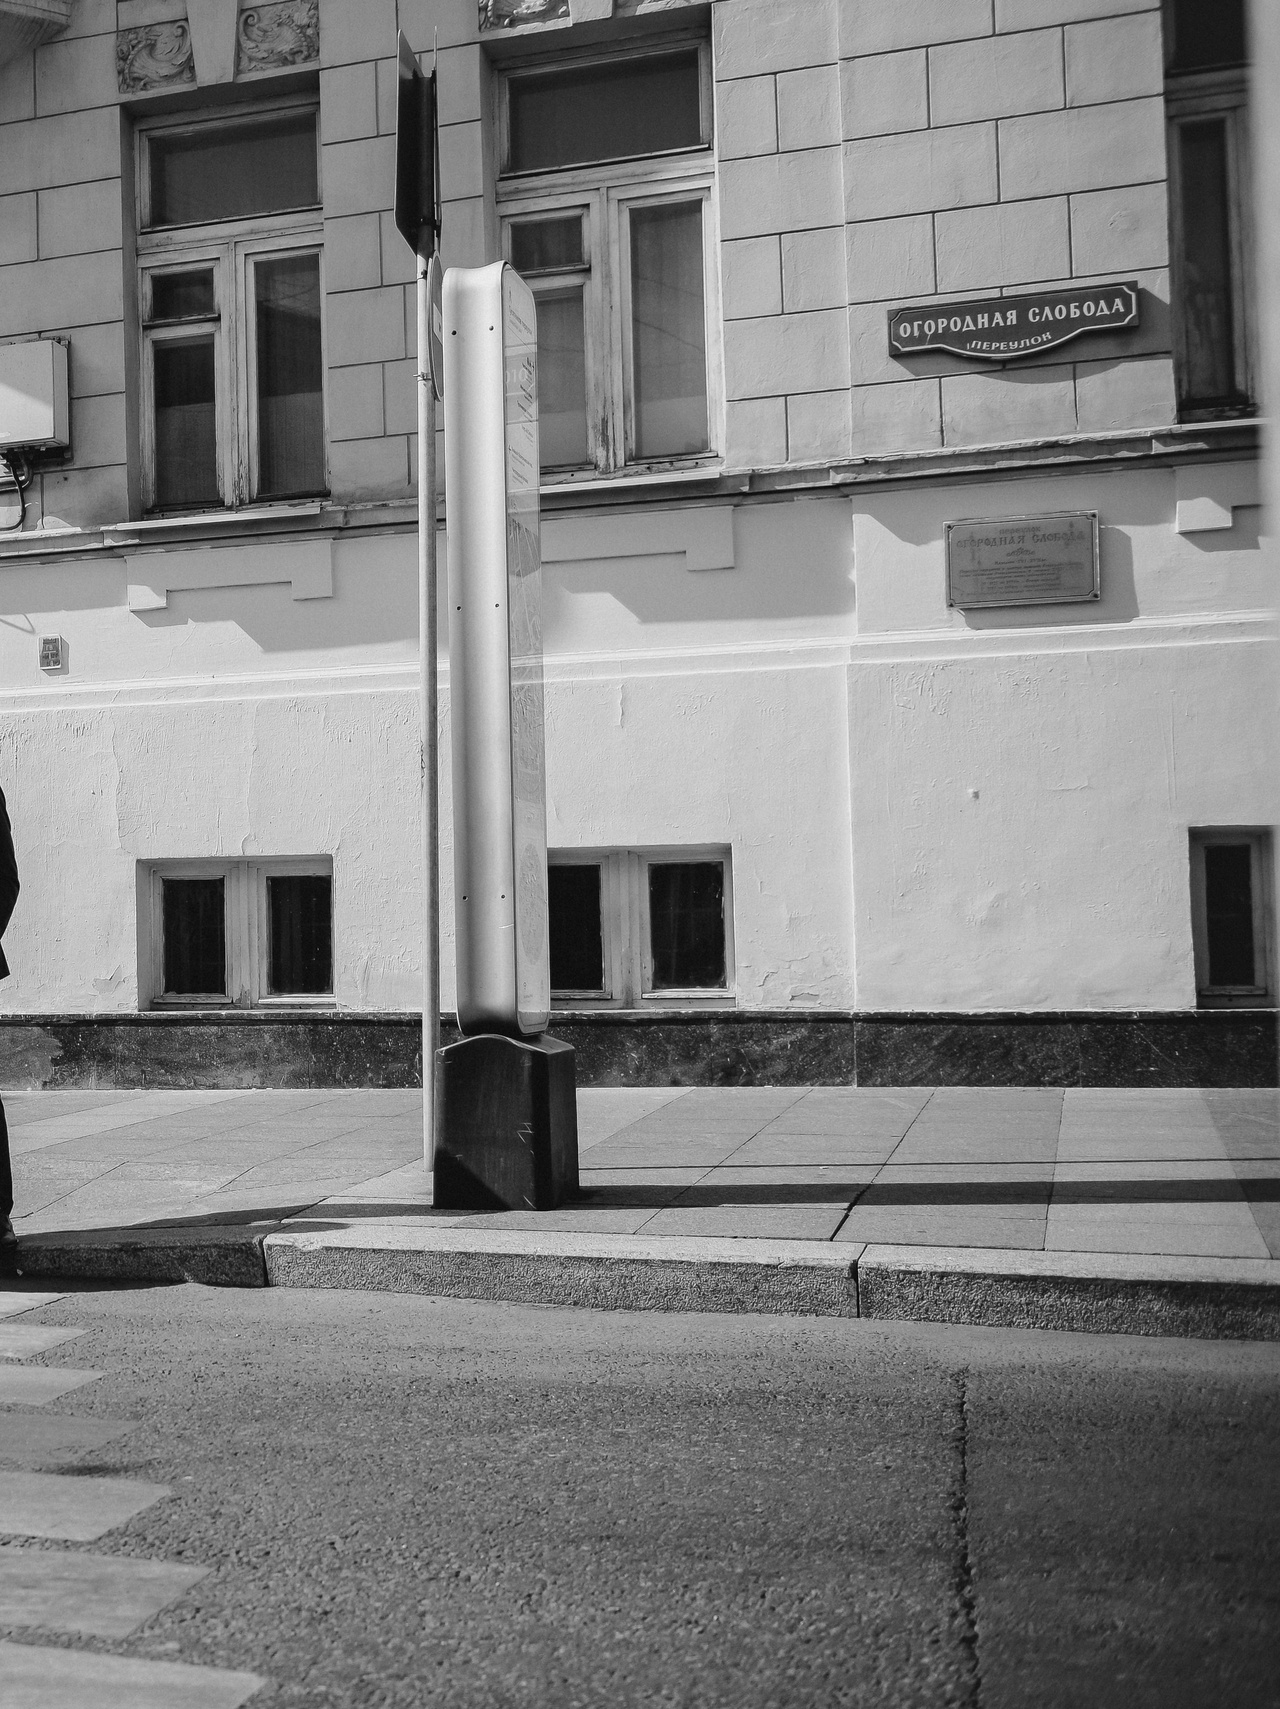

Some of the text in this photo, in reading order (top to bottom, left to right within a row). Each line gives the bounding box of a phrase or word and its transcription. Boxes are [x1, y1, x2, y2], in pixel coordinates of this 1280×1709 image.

[899, 297, 1125, 338] ОГОРОДНАЯ СЛОБОДА
[970, 331, 1052, 351] ПЕРЕУЛОК
